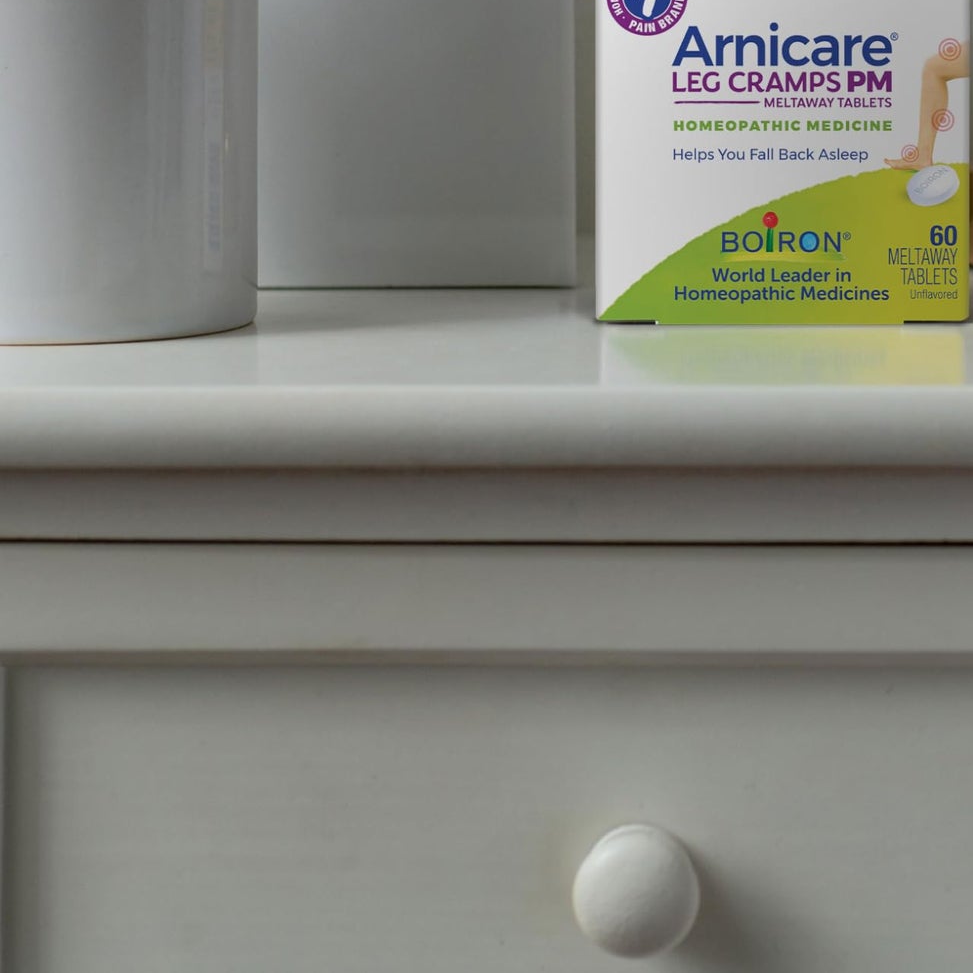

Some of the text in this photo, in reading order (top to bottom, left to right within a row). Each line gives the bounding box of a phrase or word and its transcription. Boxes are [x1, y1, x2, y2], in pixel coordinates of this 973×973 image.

[628, 19, 656, 33] PAIN
[672, 71, 892, 93] LEG CRAMPS PM
[764, 97, 892, 109] MELTAWAY TABLETS
[673, 120, 893, 132] HOMEOPATHIC MEDICINE
[673, 148, 869, 165] Helps You Fall Back Asleep
[930, 225, 958, 246] 60
[888, 247, 958, 265] MELTAWAY
[712, 267, 852, 283] World Leader in
[901, 267, 958, 285] TABLETS
[674, 285, 890, 305] Homeopathic Medicines
[910, 288, 958, 300] Unflavored
